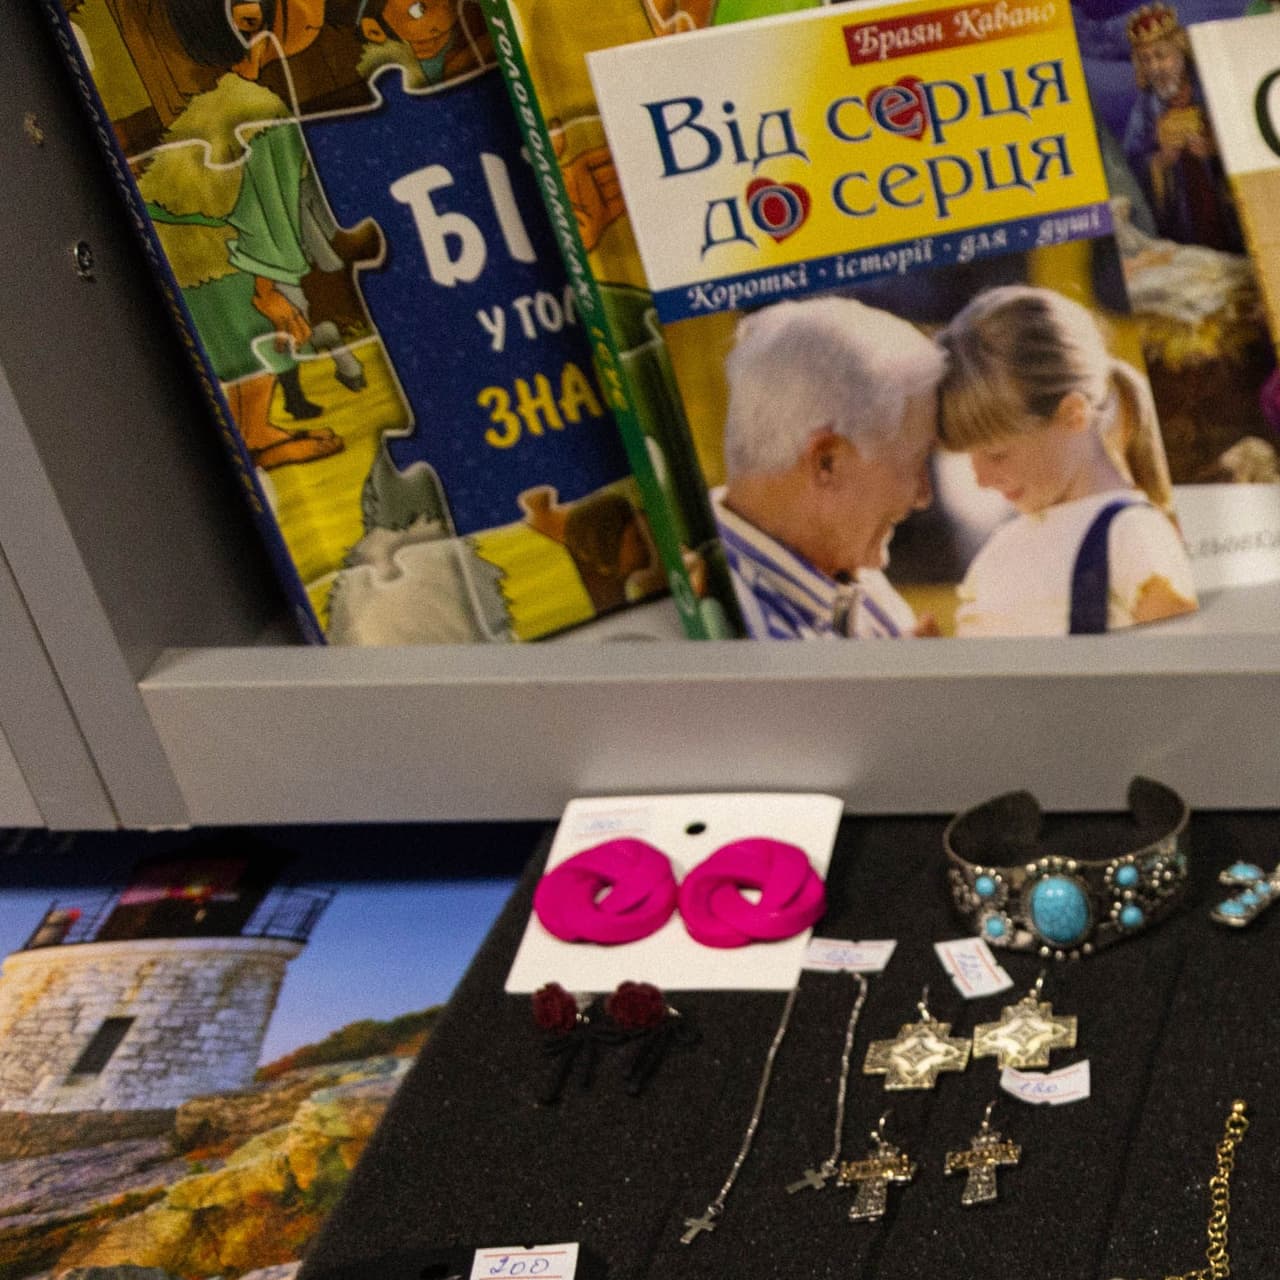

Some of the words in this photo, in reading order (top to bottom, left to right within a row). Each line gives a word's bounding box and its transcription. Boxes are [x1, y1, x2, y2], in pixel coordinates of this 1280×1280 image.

[852, 24, 945, 63] Браян
[641, 95, 812, 179] Від
[825, 58, 1072, 146] серця
[389, 148, 537, 288] БІ
[700, 184, 803, 261] до
[831, 134, 1076, 220] серця
[688, 263, 809, 310] Короткі
[834, 238, 935, 281] історії
[956, 226, 1009, 263] для
[1037, 206, 1102, 246] душі
[476, 362, 605, 449] ЗНА
[489, 1255, 550, 1275] 200
